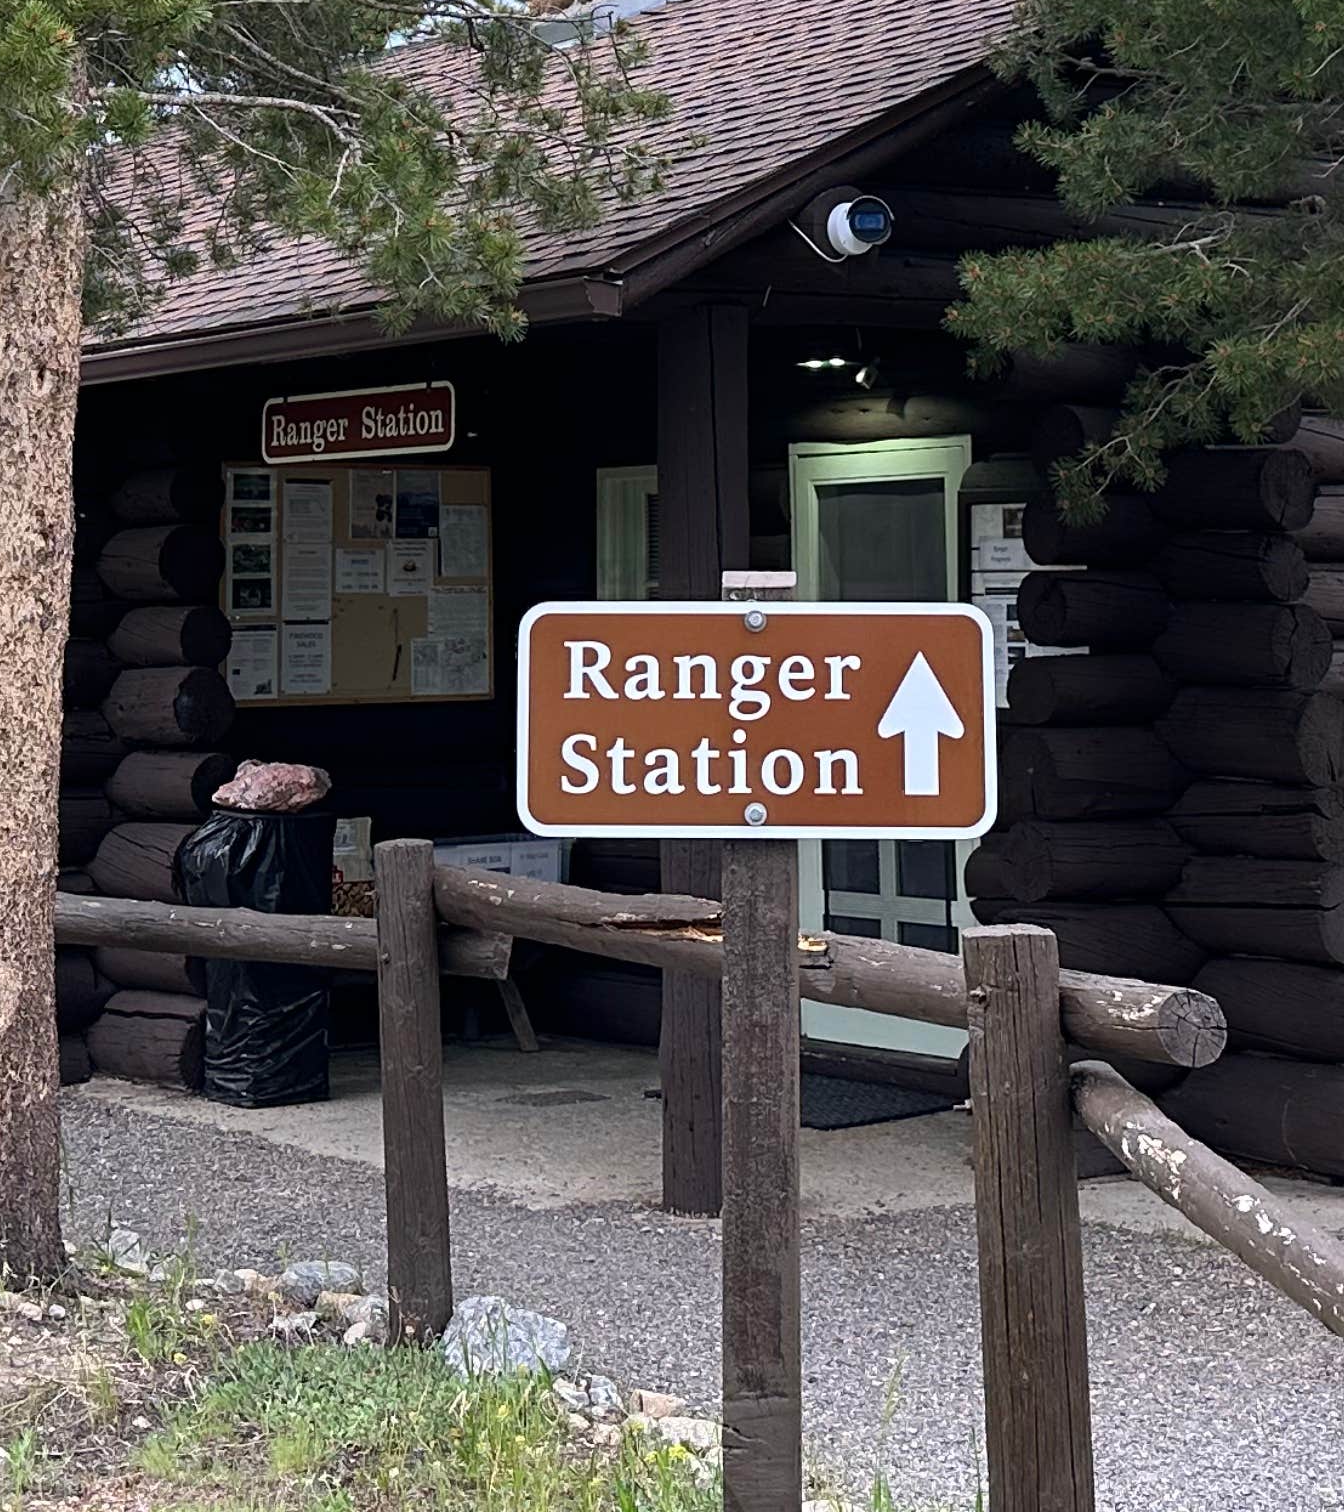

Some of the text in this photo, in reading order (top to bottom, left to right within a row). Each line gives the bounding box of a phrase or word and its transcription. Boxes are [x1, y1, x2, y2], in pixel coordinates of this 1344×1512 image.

[270, 403, 444, 452] Ranger Station
[562, 640, 862, 722] Ranger
[560, 728, 864, 796] Station
